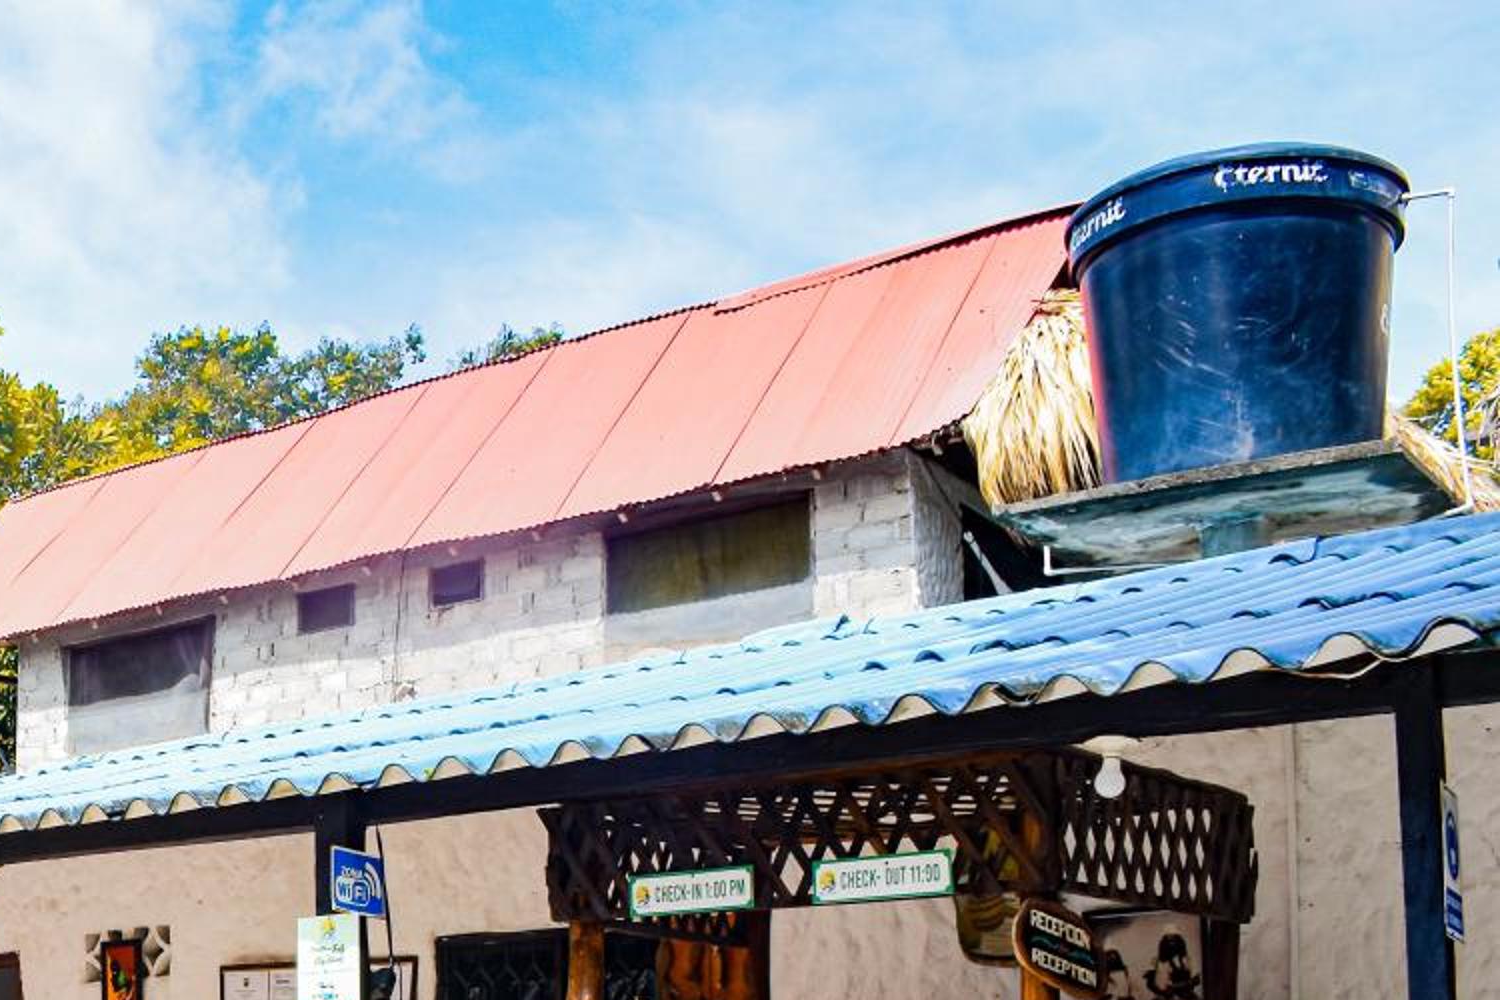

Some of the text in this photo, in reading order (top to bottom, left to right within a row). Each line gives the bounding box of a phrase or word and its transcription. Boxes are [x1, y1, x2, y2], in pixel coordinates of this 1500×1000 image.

[885, 865, 906, 886] OUT
[655, 882, 701, 903] CHECK-IN
[729, 878, 745, 897] PM
[1031, 947, 1097, 987] RECEPTION
